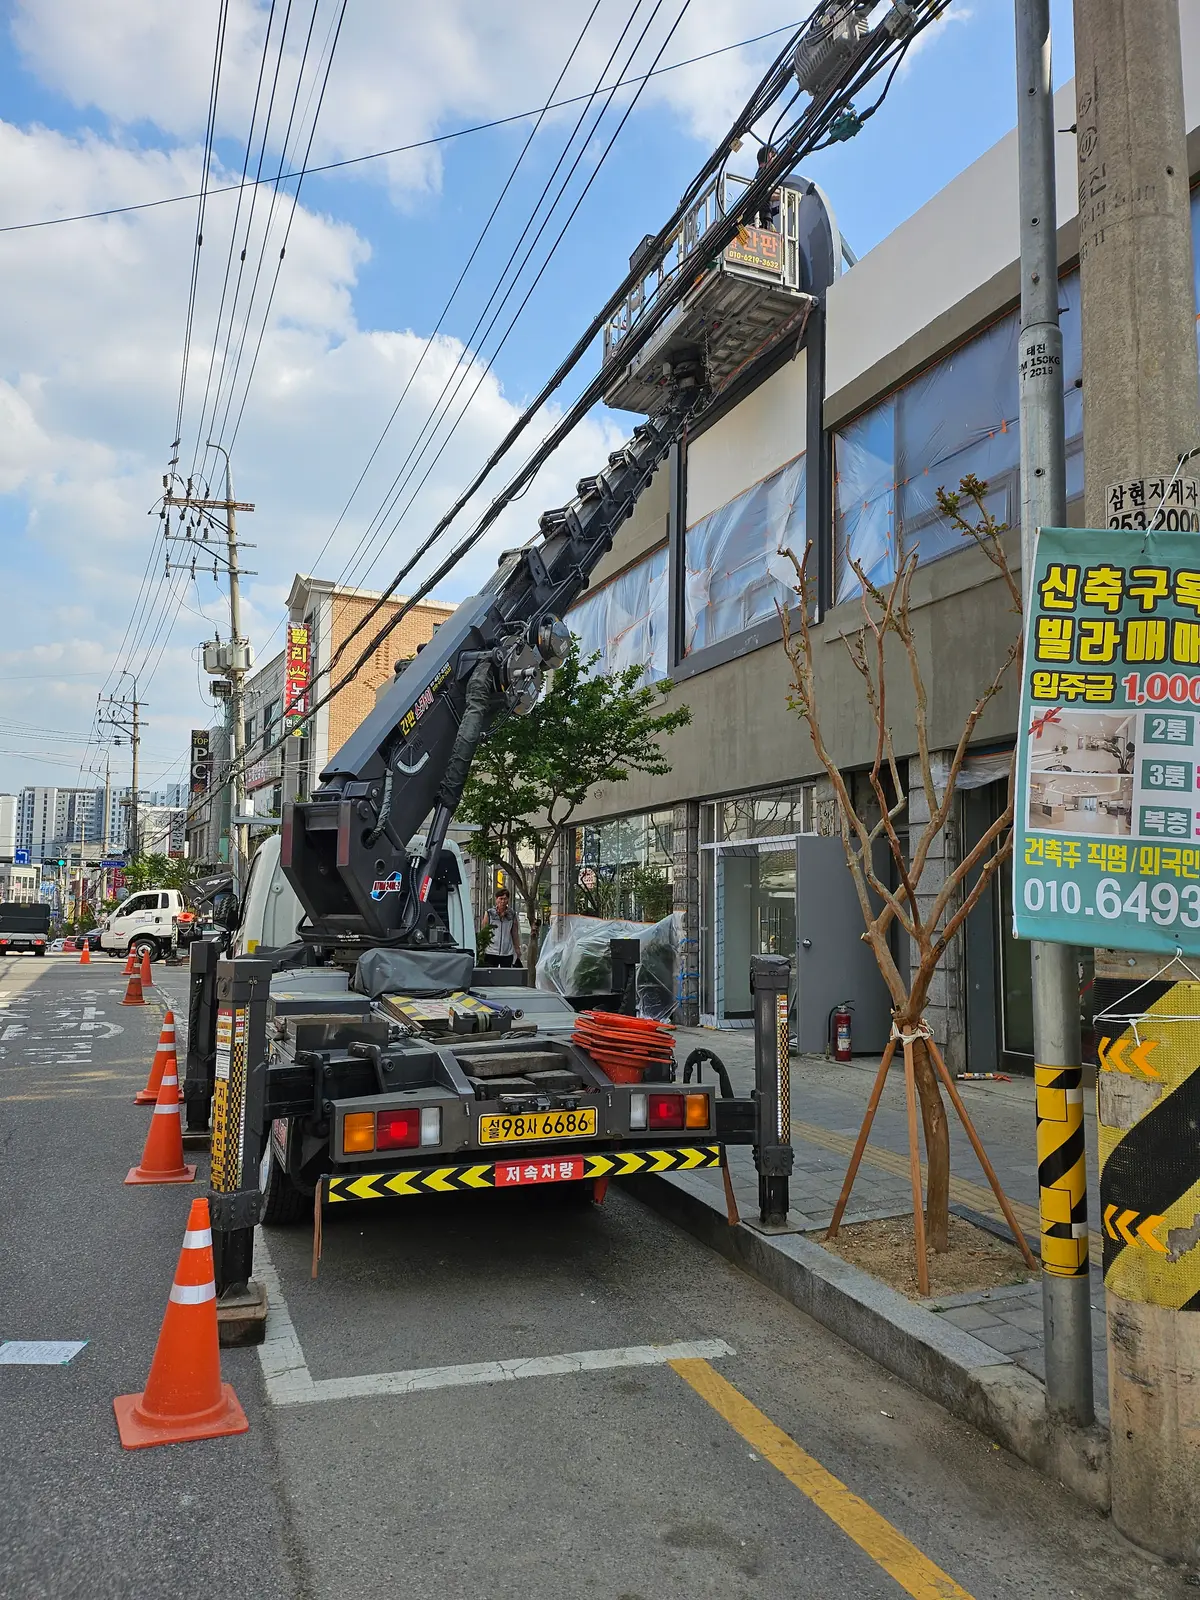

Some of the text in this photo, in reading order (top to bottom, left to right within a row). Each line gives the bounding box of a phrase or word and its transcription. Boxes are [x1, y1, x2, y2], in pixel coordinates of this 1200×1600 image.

[729, 250, 779, 269] 010-6219-3632
[1030, 355, 1061, 367] 150KG
[1031, 670, 1117, 702] 입주금
[193, 737, 209, 745] TOP
[1151, 718, 1187, 742] 2룸
[192, 747, 208, 779] PC
[1149, 764, 1186, 788] 3룸
[1144, 810, 1188, 835] 복층
[1024, 837, 1082, 870] 건축주
[1023, 877, 1200, 928] 010.6493
[542, 1112, 589, 1135] 6686
[506, 1161, 574, 1183] 저속차량
